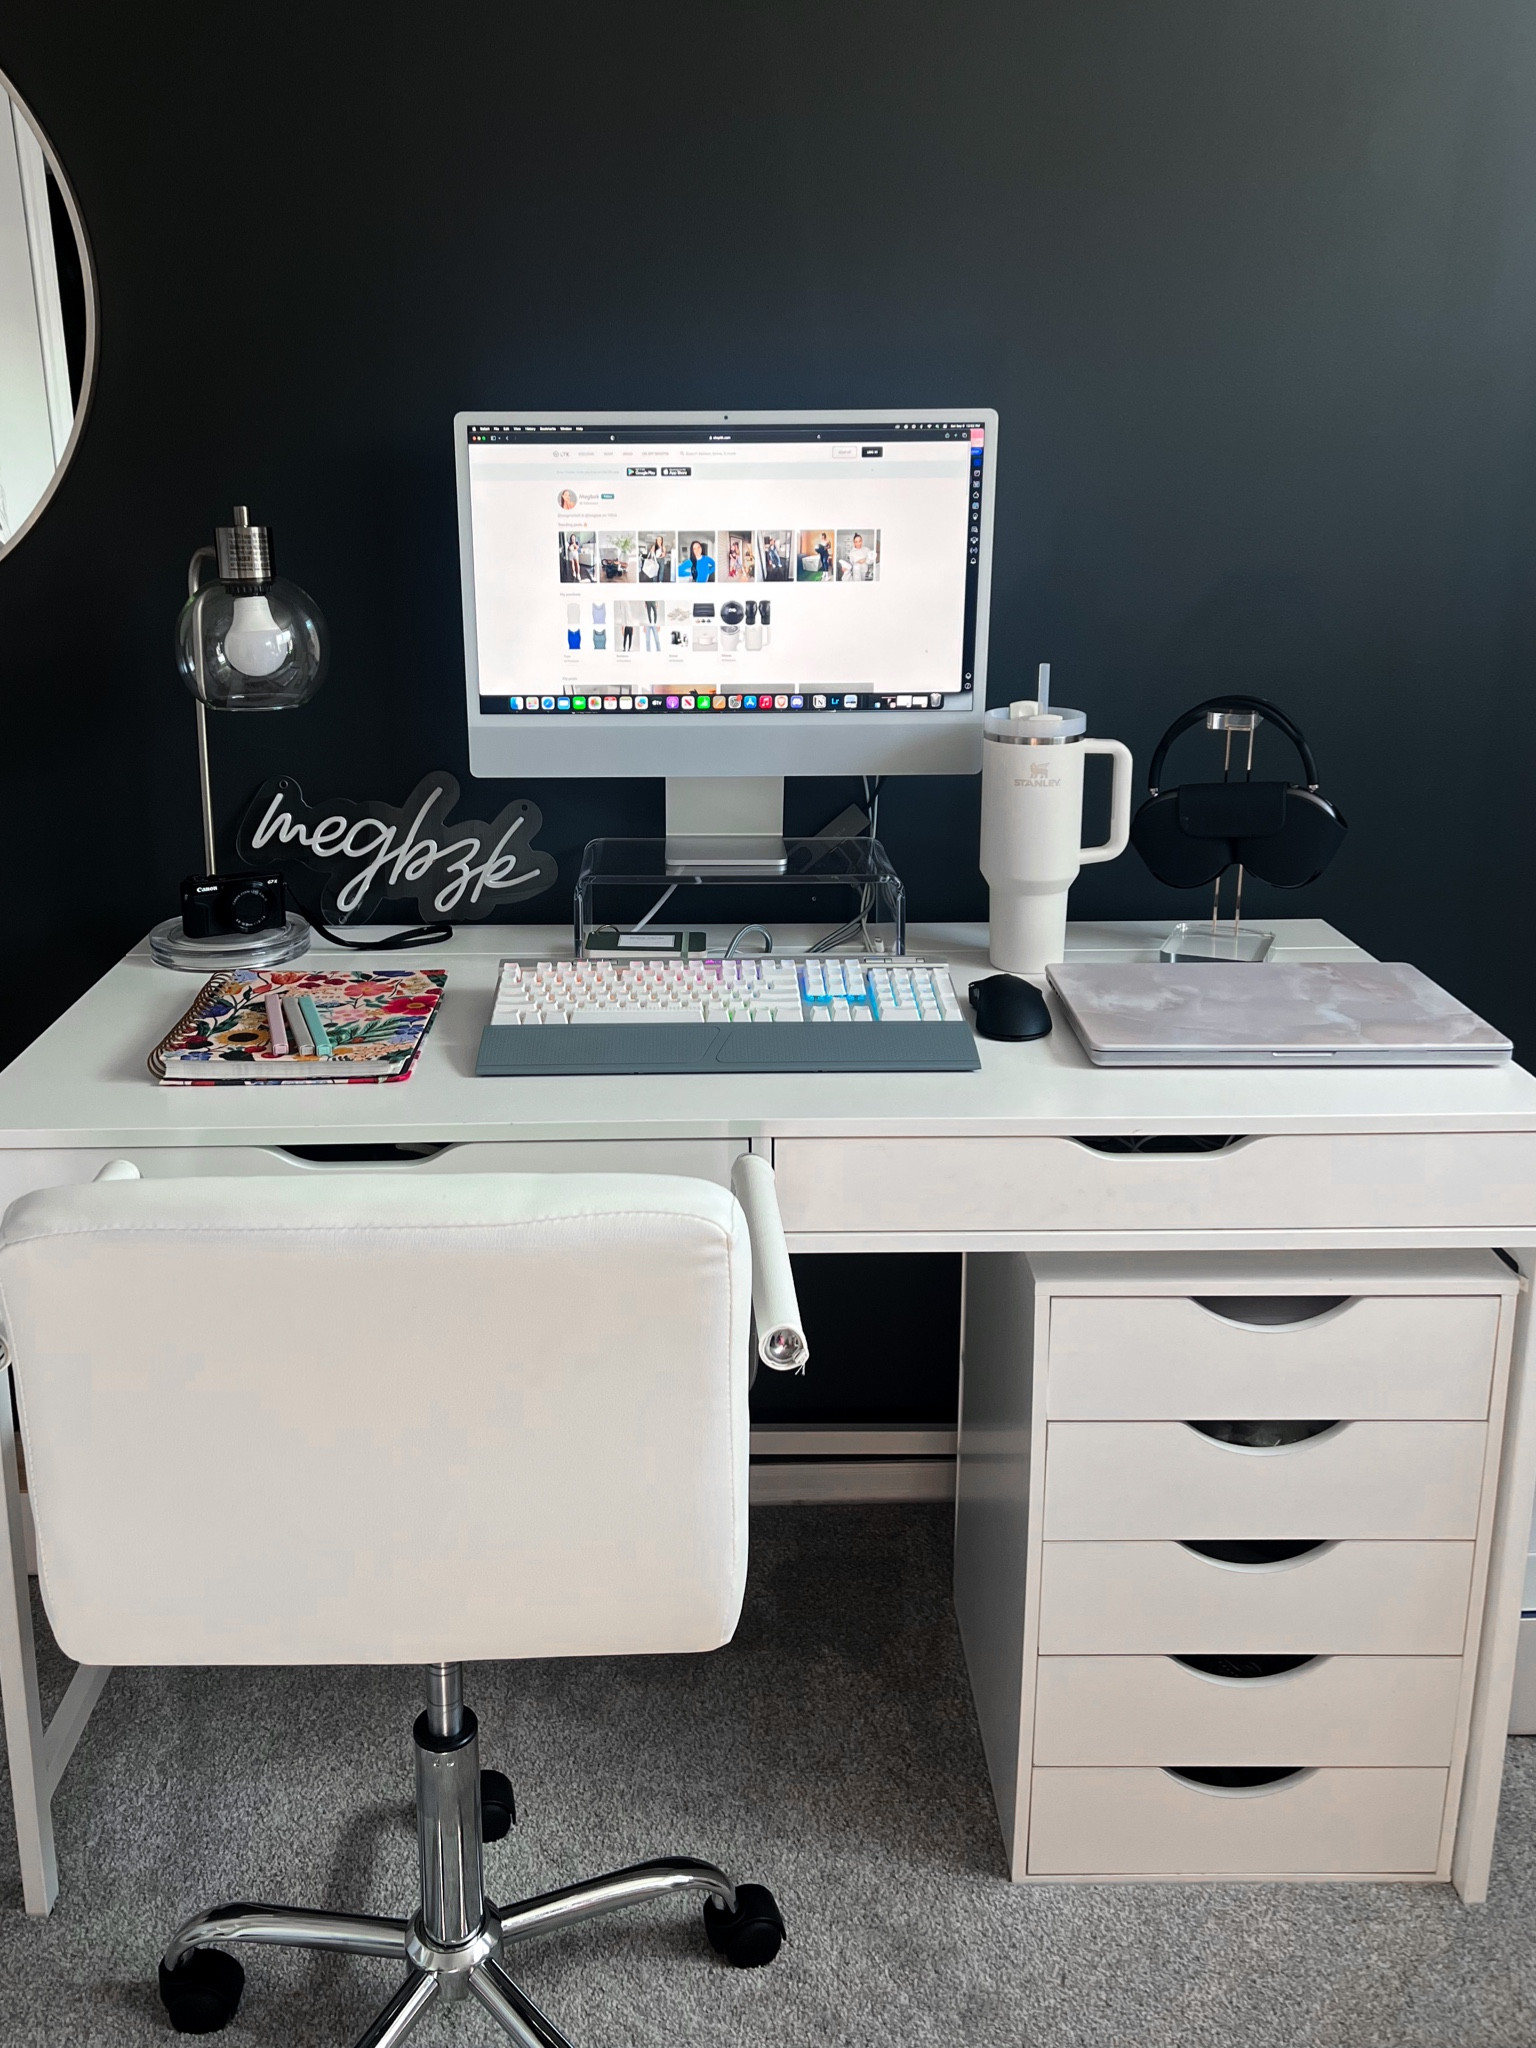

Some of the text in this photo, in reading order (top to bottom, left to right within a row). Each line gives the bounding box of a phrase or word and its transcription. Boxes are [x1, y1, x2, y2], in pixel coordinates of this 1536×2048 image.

[831, 697, 840, 705] Lr
[1013, 778, 1061, 787] STANLEY
[251, 786, 541, 913] megbzk
[196, 885, 218, 893] Canon
